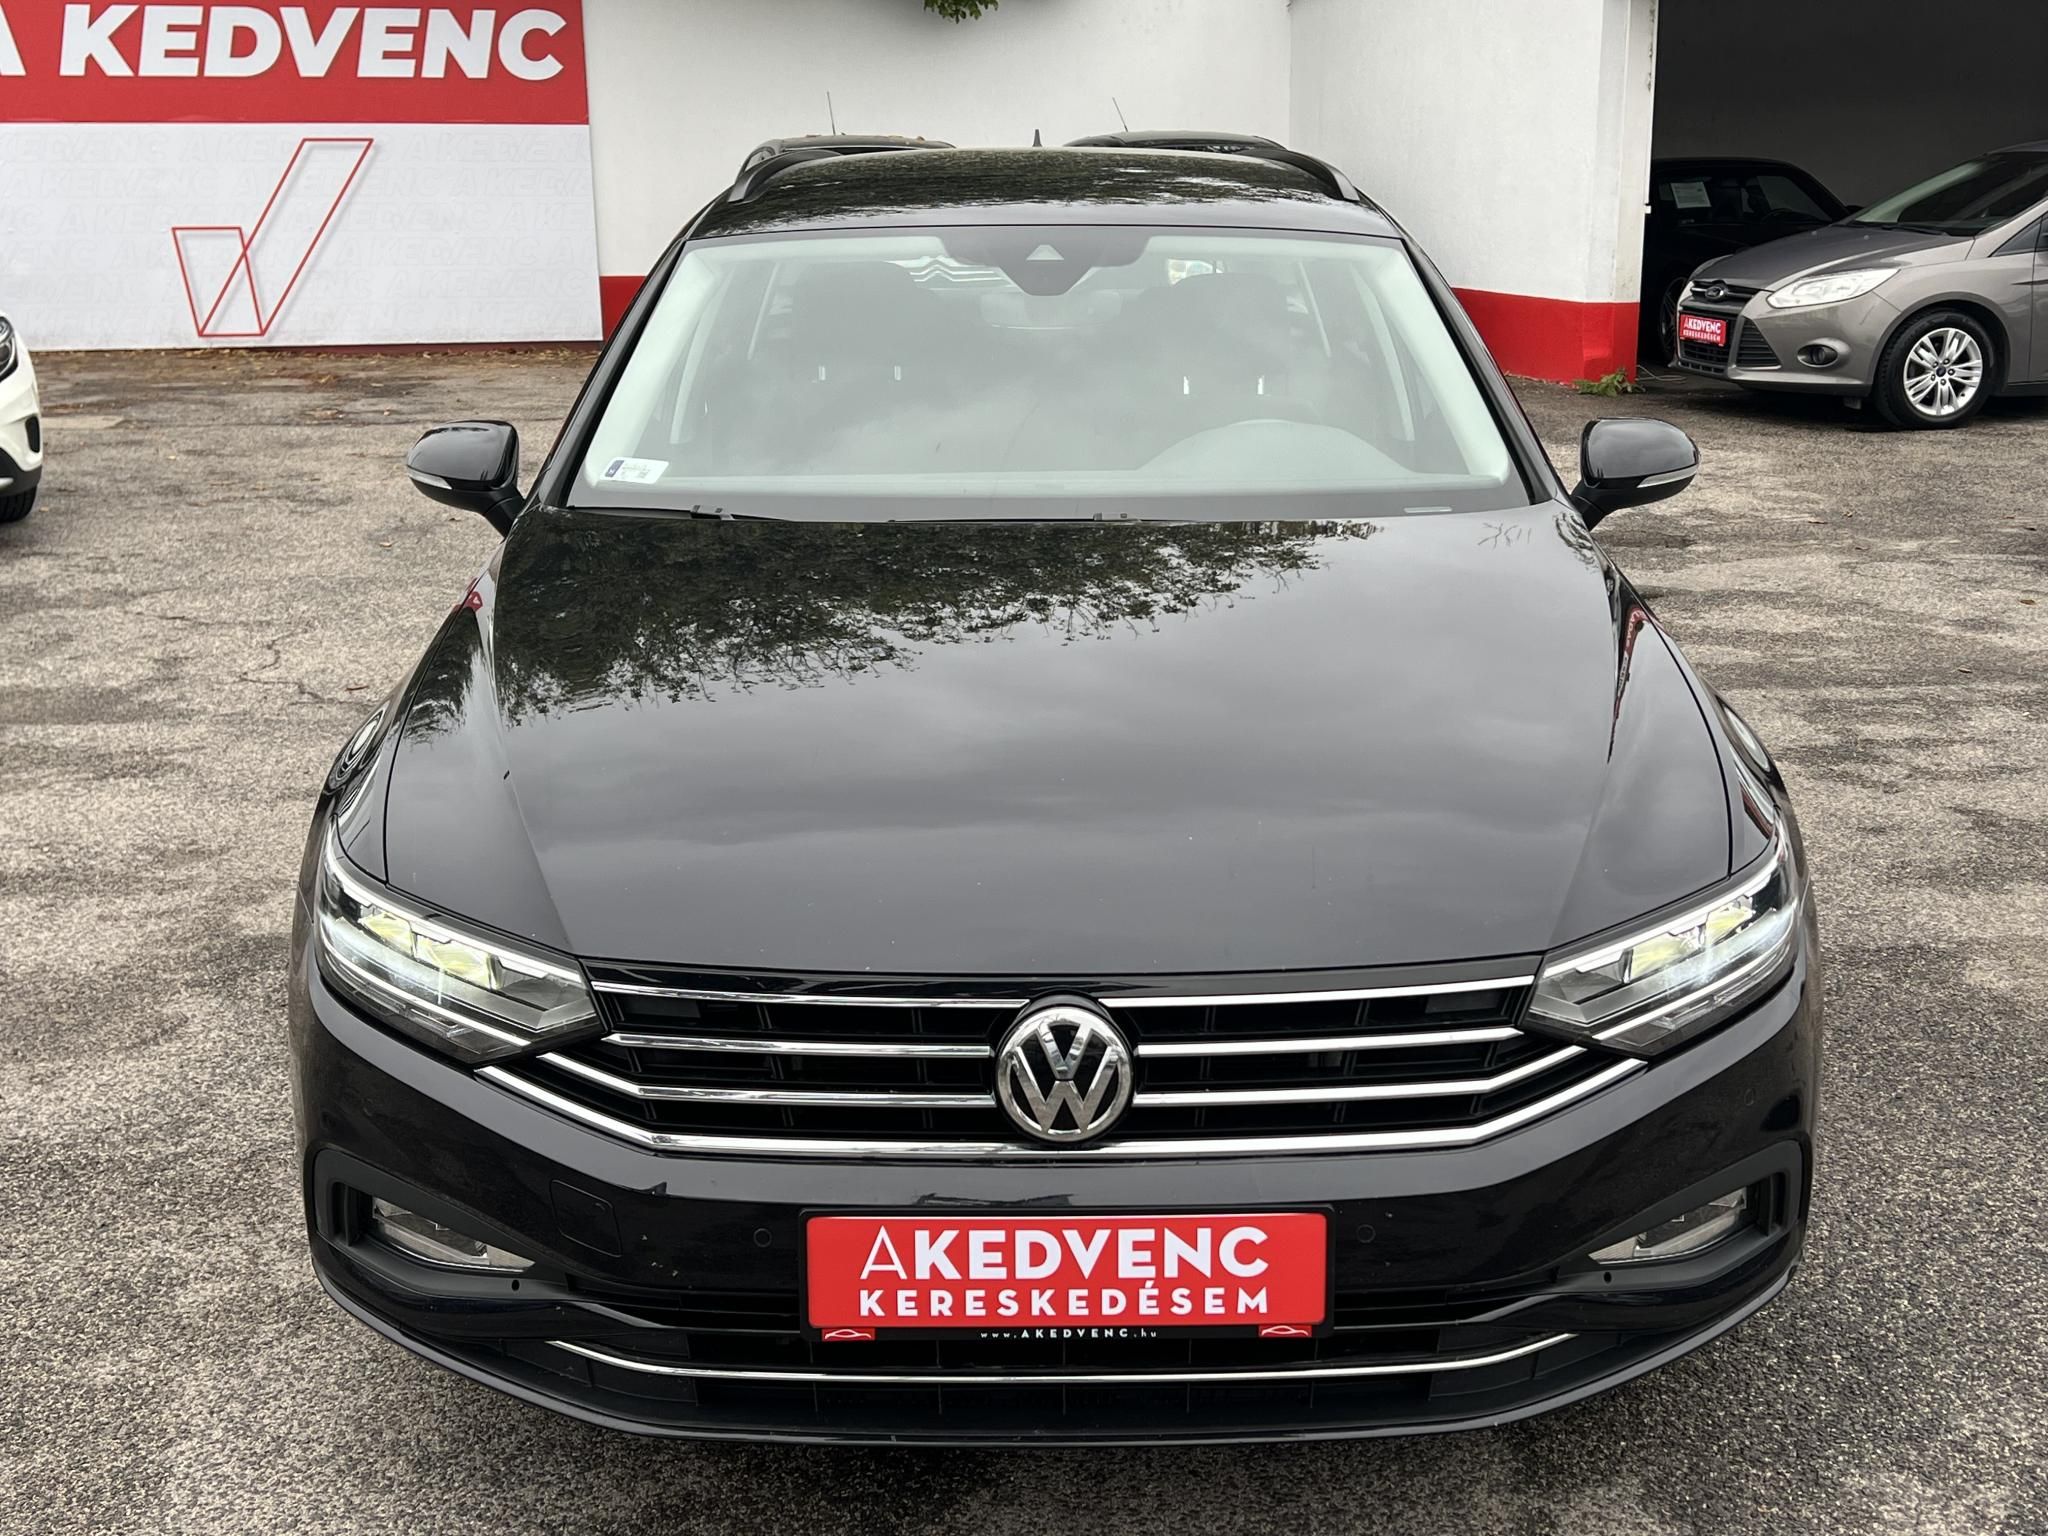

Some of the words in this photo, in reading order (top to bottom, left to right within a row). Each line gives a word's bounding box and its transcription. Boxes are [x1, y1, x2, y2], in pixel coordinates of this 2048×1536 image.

[59, 3, 567, 81] KEDVENC
[860, 1225, 1269, 1281] AKEDVENC
[859, 1279, 1268, 1317] KERESKEDÉSEM
[980, 1327, 1157, 1339] www.AKEDVENC.hu
